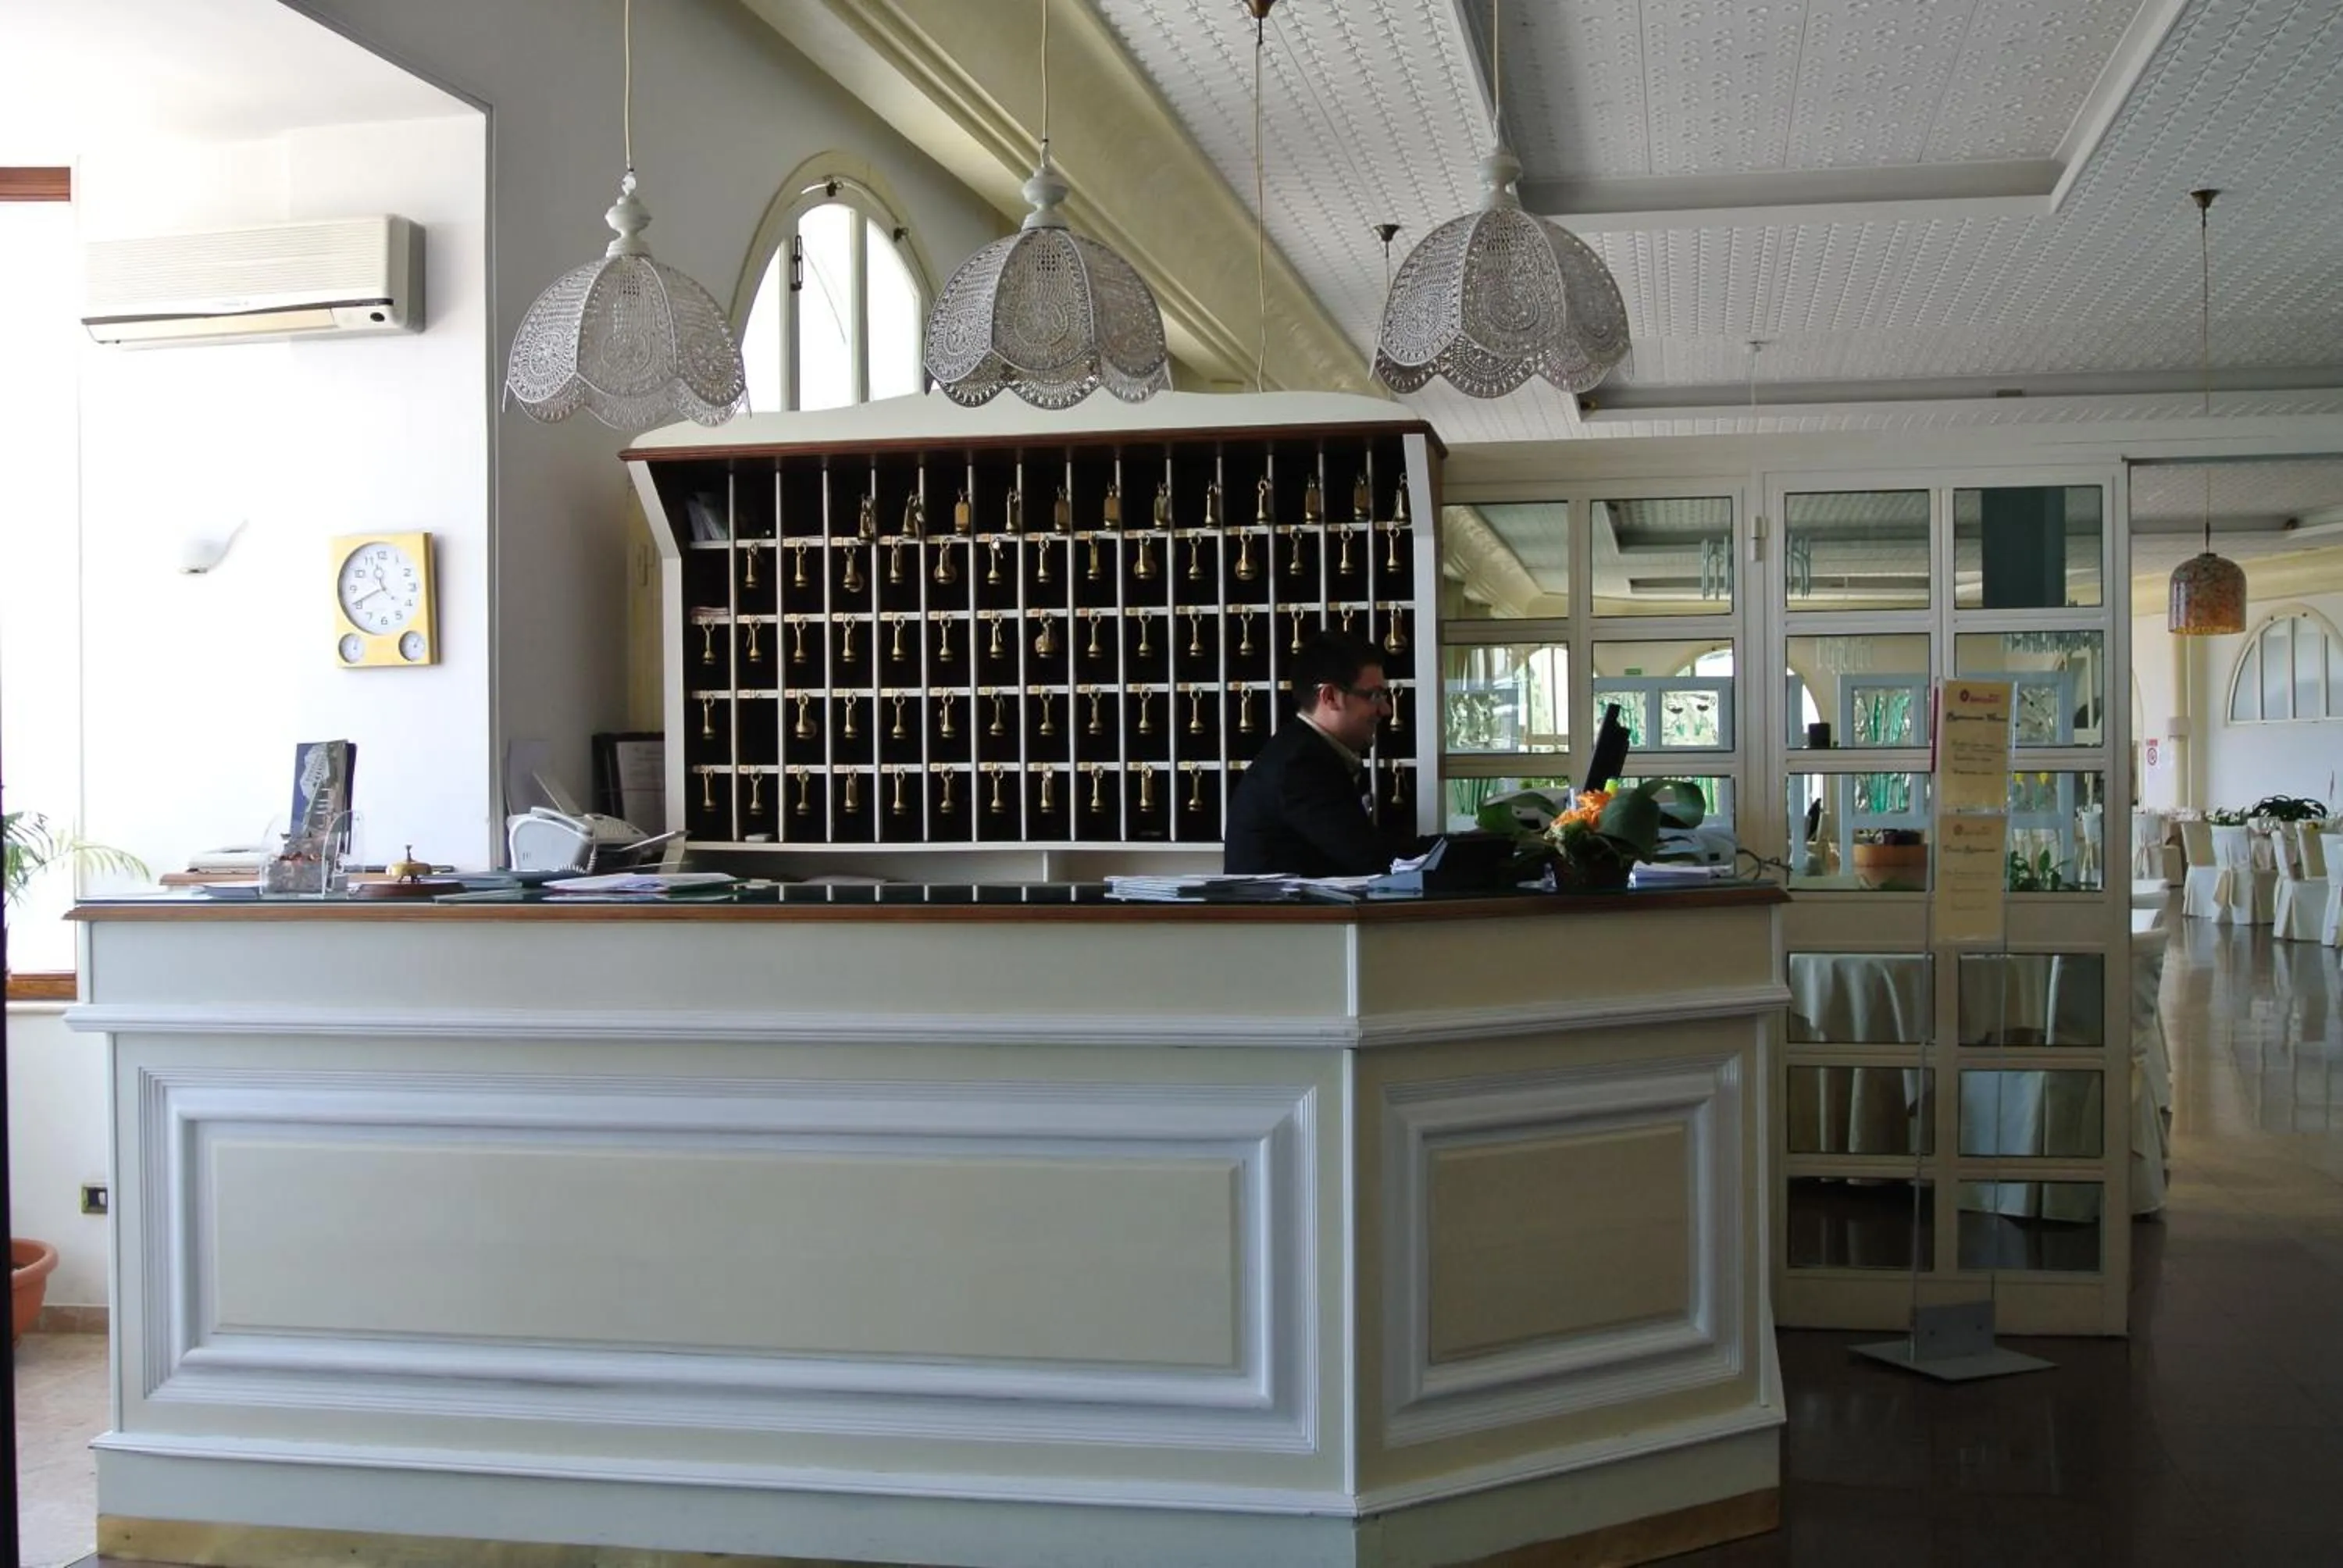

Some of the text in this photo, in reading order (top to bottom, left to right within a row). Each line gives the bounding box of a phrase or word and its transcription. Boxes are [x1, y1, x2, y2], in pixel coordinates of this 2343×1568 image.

[377, 551, 387, 560] 12
[365, 556, 373, 565] 11
[350, 585, 358, 593] 9
[408, 583, 417, 592] 3
[355, 600, 363, 610] 8
[366, 612, 373, 621] 7
[396, 611, 402, 620] 5
[381, 616, 387, 625] 6
